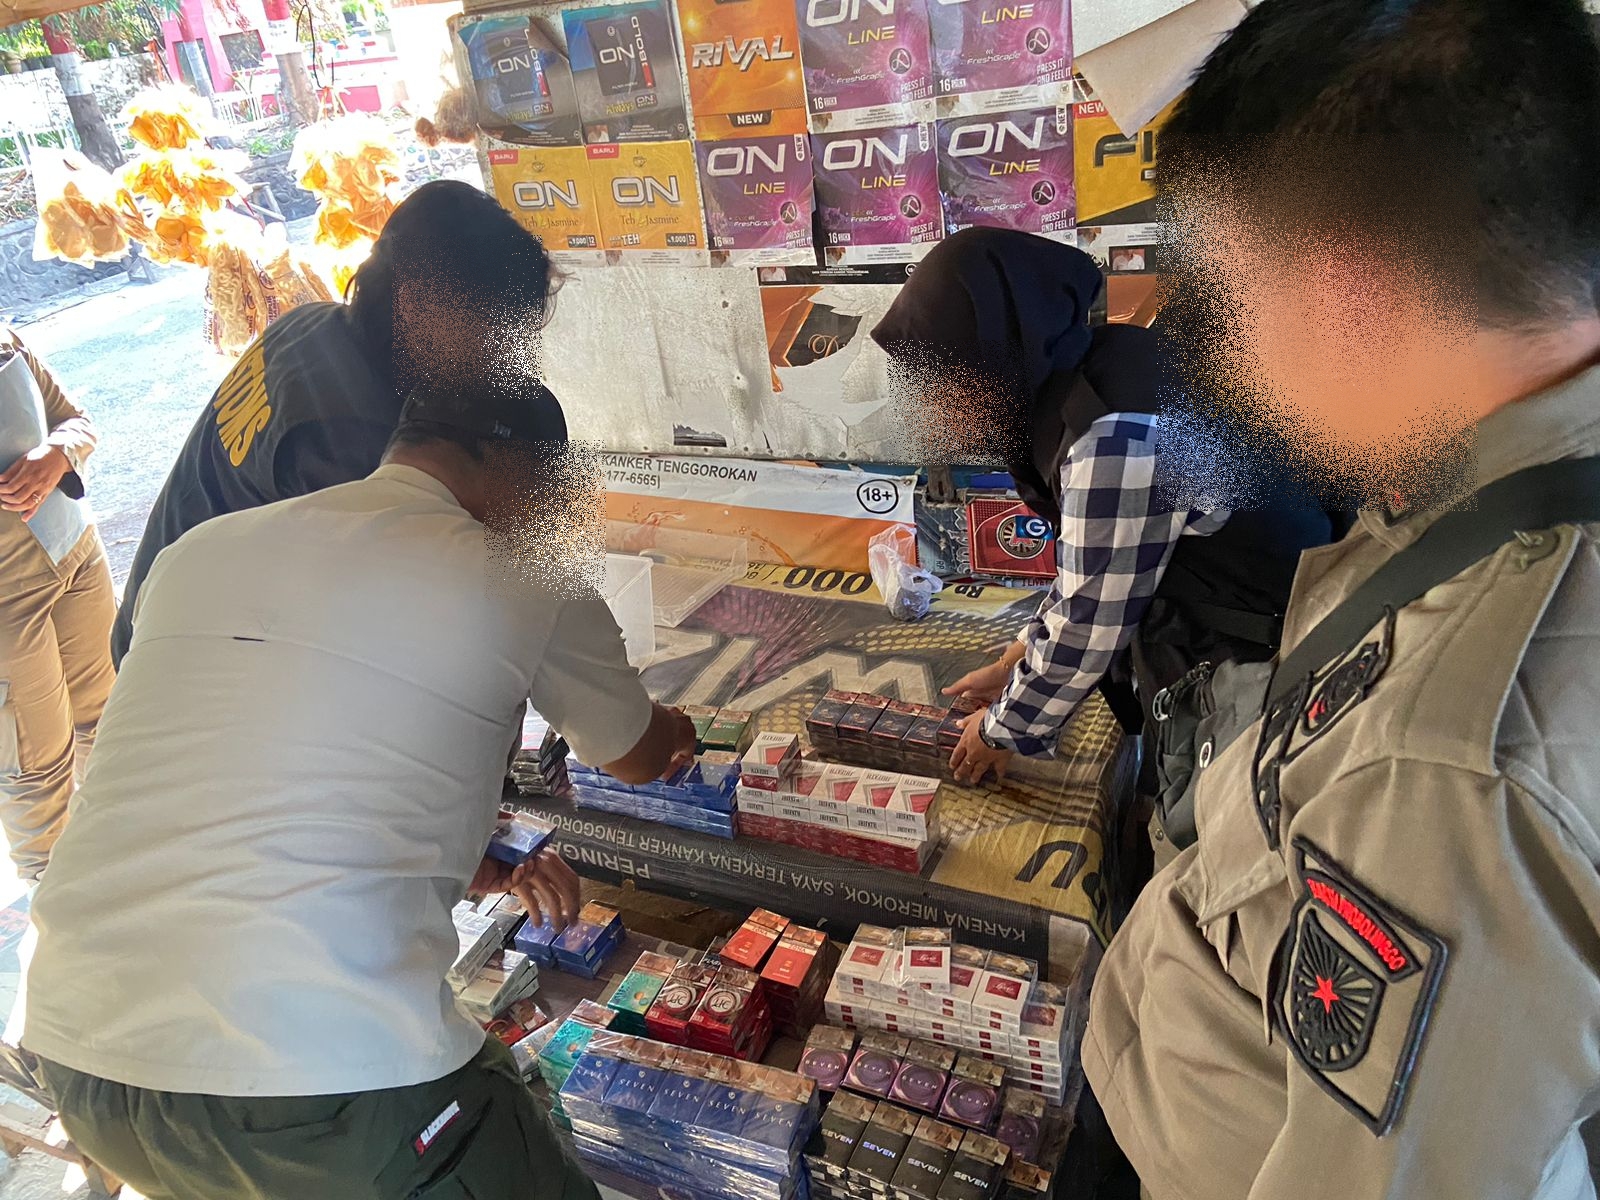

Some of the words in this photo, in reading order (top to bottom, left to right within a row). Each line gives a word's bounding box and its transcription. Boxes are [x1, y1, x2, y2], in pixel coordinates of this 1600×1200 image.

[981, 4, 1035, 25] LINE
[848, 26, 895, 45] LINE
[600, 44, 636, 64] ON
[692, 35, 794, 72] RIVAL
[497, 54, 530, 73] ON
[1037, 60, 1056, 74] PRESS
[1051, 70, 1065, 84] FEEL
[900, 79, 918, 93] PRESS
[939, 77, 950, 93] 16
[914, 86, 927, 100] FEEL
[605, 101, 635, 114] Always
[813, 97, 823, 110] 16
[1078, 102, 1104, 114] NEW
[737, 113, 763, 125] NEW
[948, 116, 1045, 158] ON
[823, 134, 908, 170] ON
[707, 143, 786, 177] ON
[989, 159, 1040, 176] LINE
[744, 182, 785, 195] LINE
[862, 175, 906, 189] LINE
[513, 180, 579, 209] ON
[611, 175, 681, 206] ON
[621, 214, 636, 225] Teh
[1041, 212, 1060, 222] PRESS
[910, 224, 927, 233] PRESS
[1054, 220, 1067, 231] FEEL
[623, 234, 639, 245] TEH
[829, 233, 838, 244] 16
[923, 231, 935, 242] FEEL
[655, 459, 758, 482] TENGGOROKAN
[862, 487, 892, 502] 18+
[640, 836, 705, 863] KANKER
[709, 852, 787, 885] TERKENA
[792, 872, 834, 896] SAYA
[839, 882, 938, 922] MEROKOK,
[944, 909, 1026, 942] KARENA
[806, 1059, 840, 1070] SEVEN
[857, 1062, 891, 1075] SEVEN
[618, 1078, 655, 1093] SEVEN
[902, 1075, 937, 1089] SEVEN
[664, 1088, 700, 1103] SEVEN
[952, 1092, 988, 1107] SEVEN
[708, 1100, 746, 1115] SEVEN
[754, 1112, 793, 1128] SEVEN
[821, 1128, 854, 1146] SEVEN
[863, 1141, 896, 1159] SEVEN
[907, 1157, 942, 1176] SEVEN
[953, 1170, 989, 1189] SEVEN
